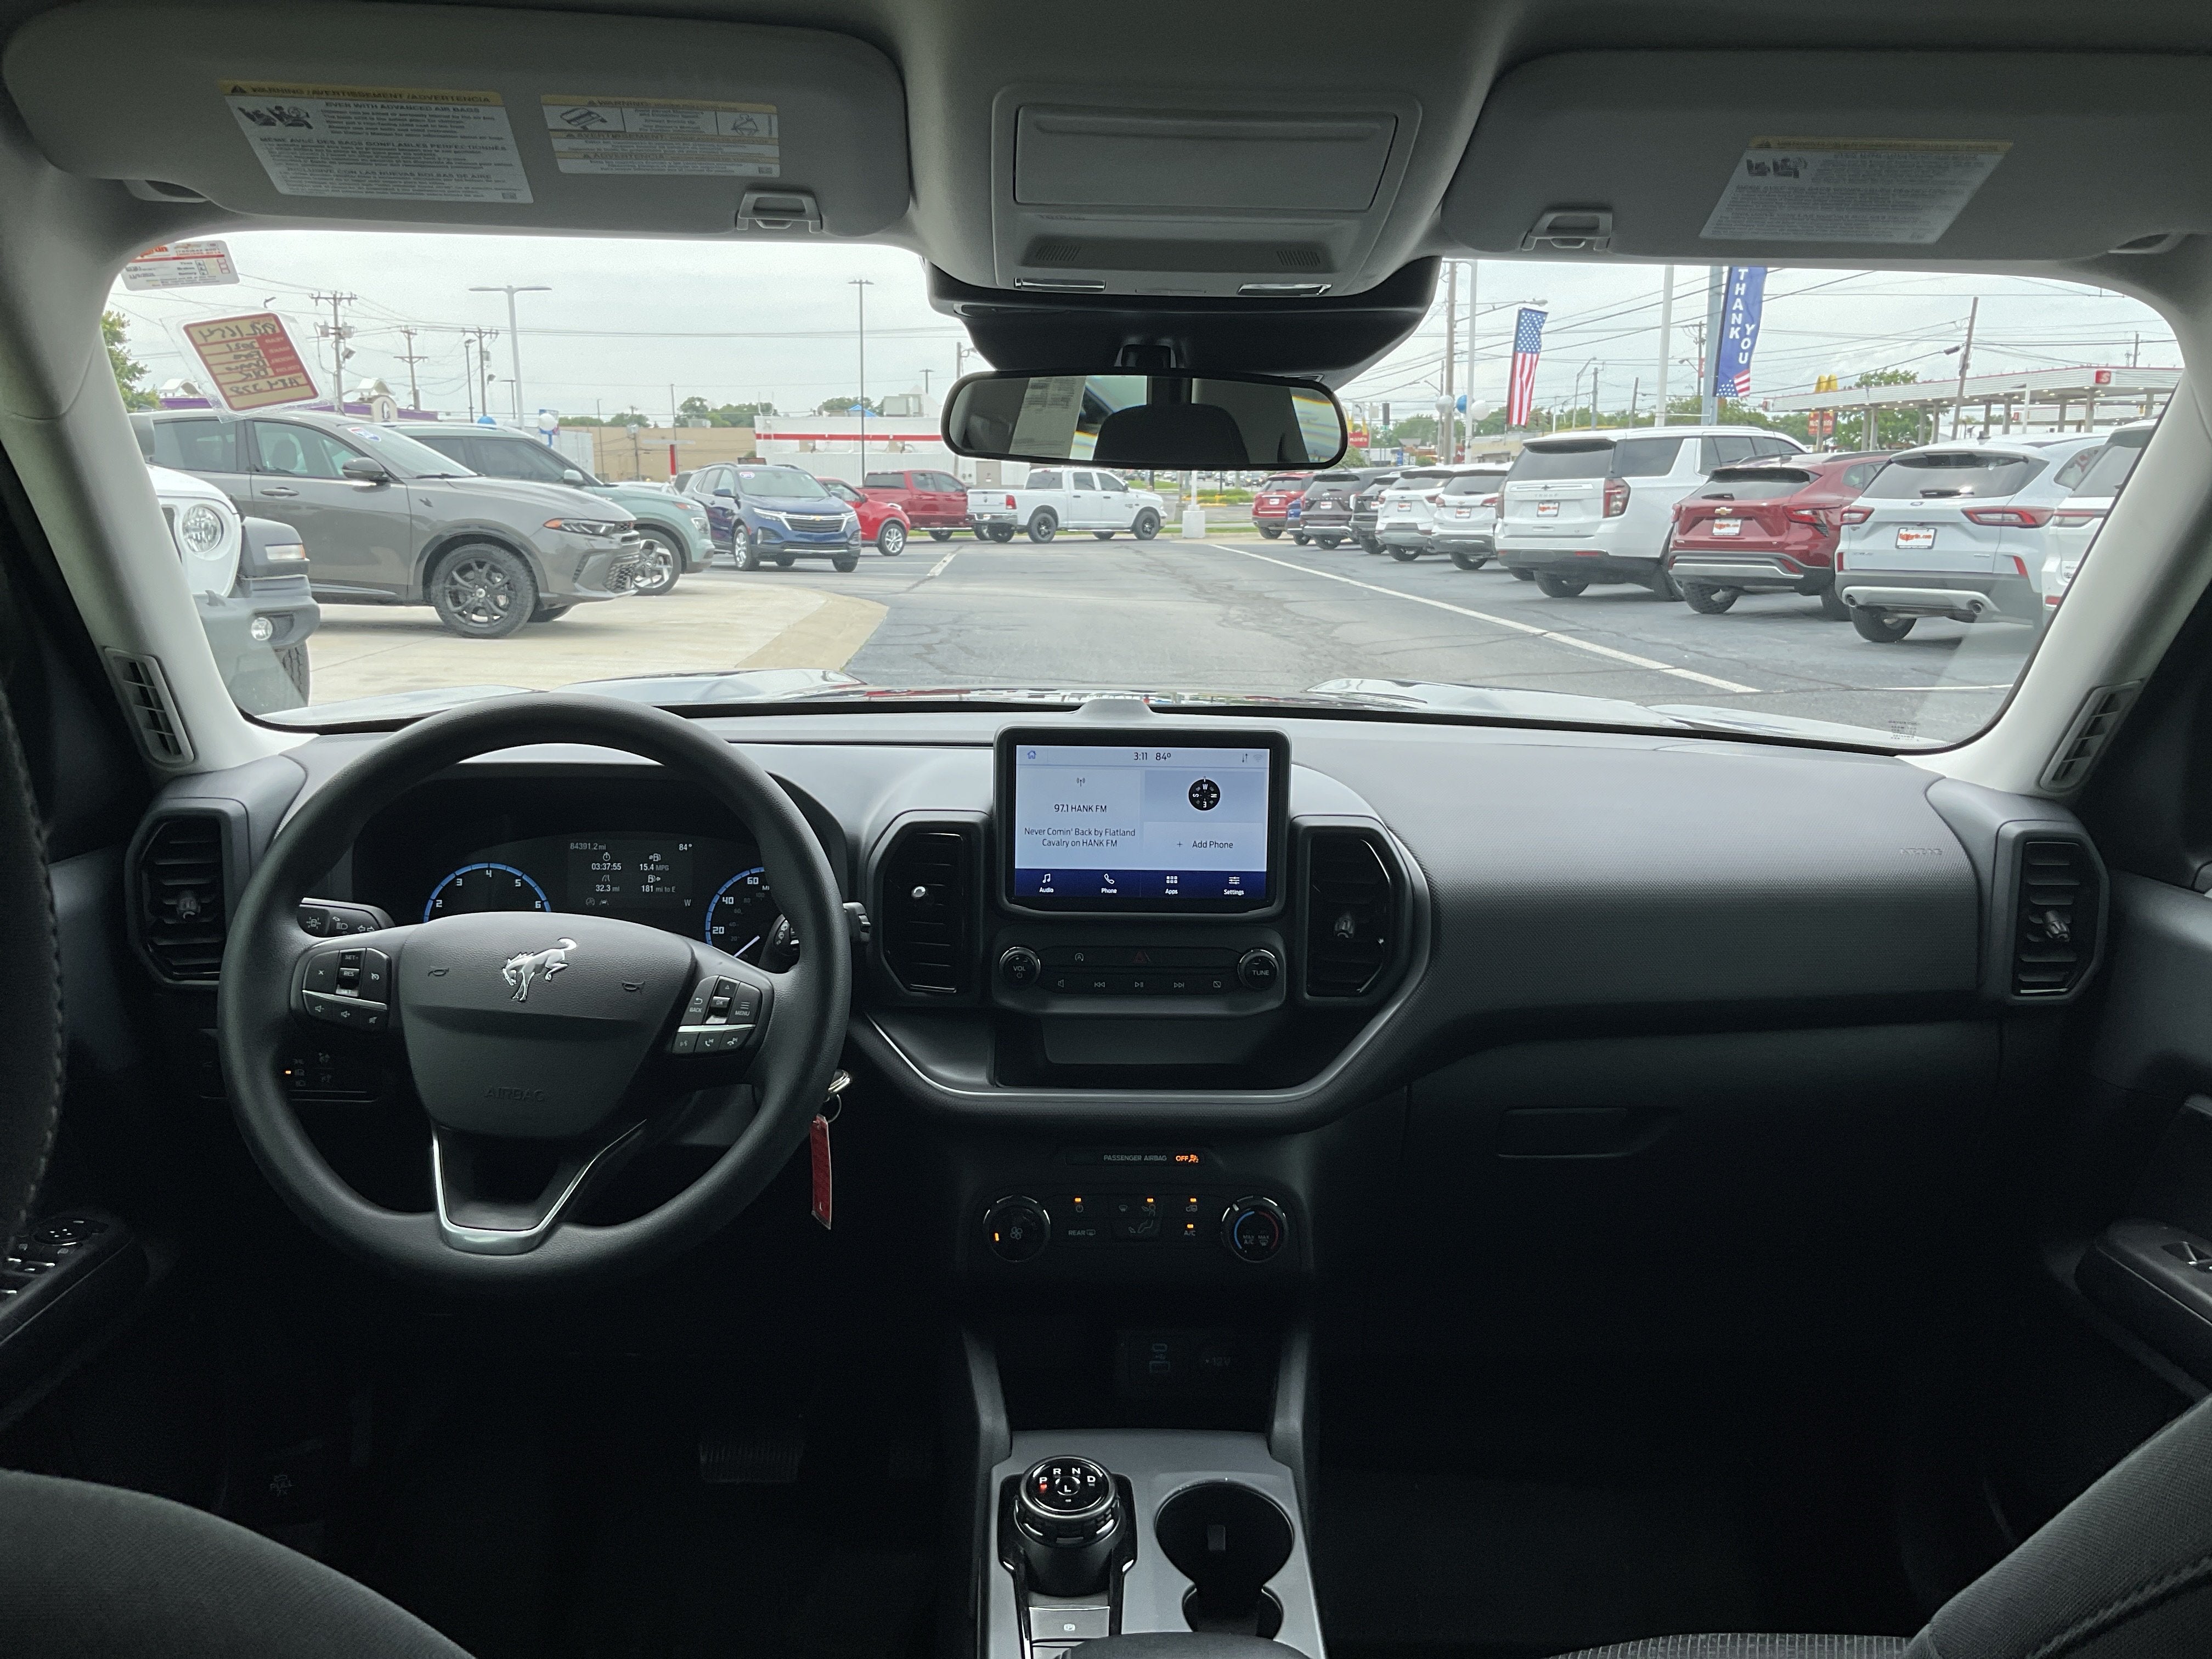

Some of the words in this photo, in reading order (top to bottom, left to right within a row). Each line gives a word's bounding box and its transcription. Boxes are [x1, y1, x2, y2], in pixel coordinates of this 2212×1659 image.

[1729, 269, 1749, 340] THANK
[1738, 324, 1756, 364] YOU
[1133, 753, 1148, 761] 3:11
[1054, 804, 1069, 813] 97.1
[1071, 804, 1094, 813] HANK
[1096, 805, 1107, 813] FM
[1024, 827, 1046, 836] Never
[1047, 827, 1074, 836] Comin'
[1075, 828, 1093, 836] Back
[1094, 828, 1103, 838] by
[1104, 828, 1136, 837] Flatland
[1042, 838, 1069, 848] Cavalry
[1082, 839, 1105, 847] HANK
[1107, 839, 1118, 848] FM
[1192, 840, 1207, 848] Add
[1209, 840, 1233, 849] Phone
[591, 862, 622, 871] 03:37:55
[486, 870, 492, 878] 4
[515, 879, 522, 887] 5
[747, 877, 759, 885] 60
[641, 884, 654, 893] 181
[1165, 888, 1178, 896] Apps
[535, 900, 541, 909] 6
[722, 896, 734, 905] 40
[712, 926, 725, 934] 20
